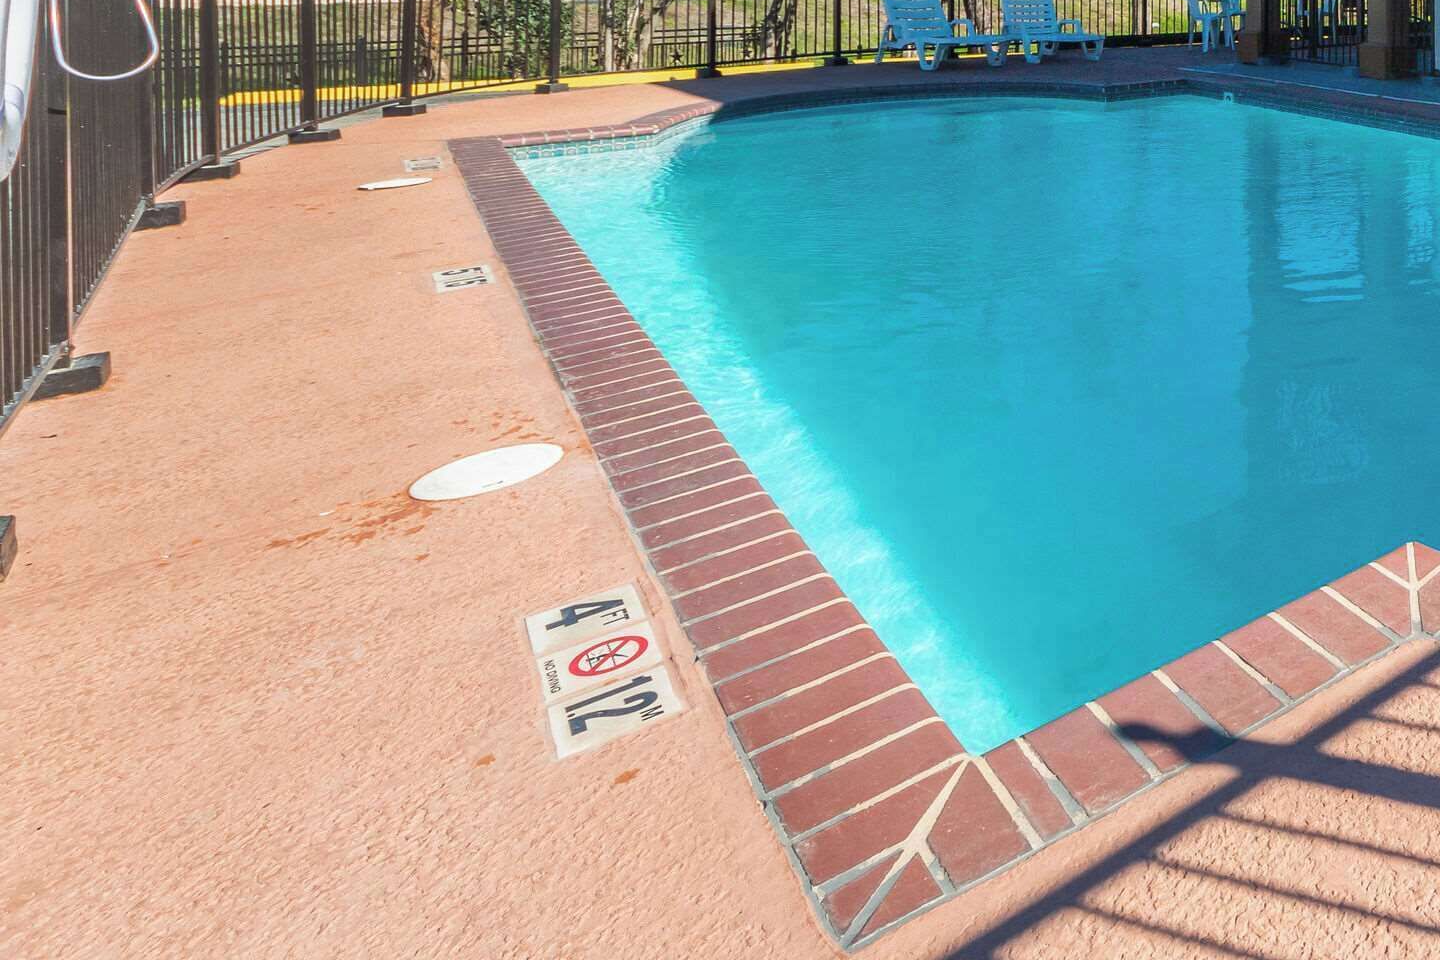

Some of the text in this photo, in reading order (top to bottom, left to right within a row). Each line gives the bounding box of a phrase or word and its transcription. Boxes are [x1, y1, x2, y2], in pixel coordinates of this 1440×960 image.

[545, 599, 630, 631] 4 FT
[546, 670, 561, 694] DIVING
[565, 675, 665, 736] 1.2 M
